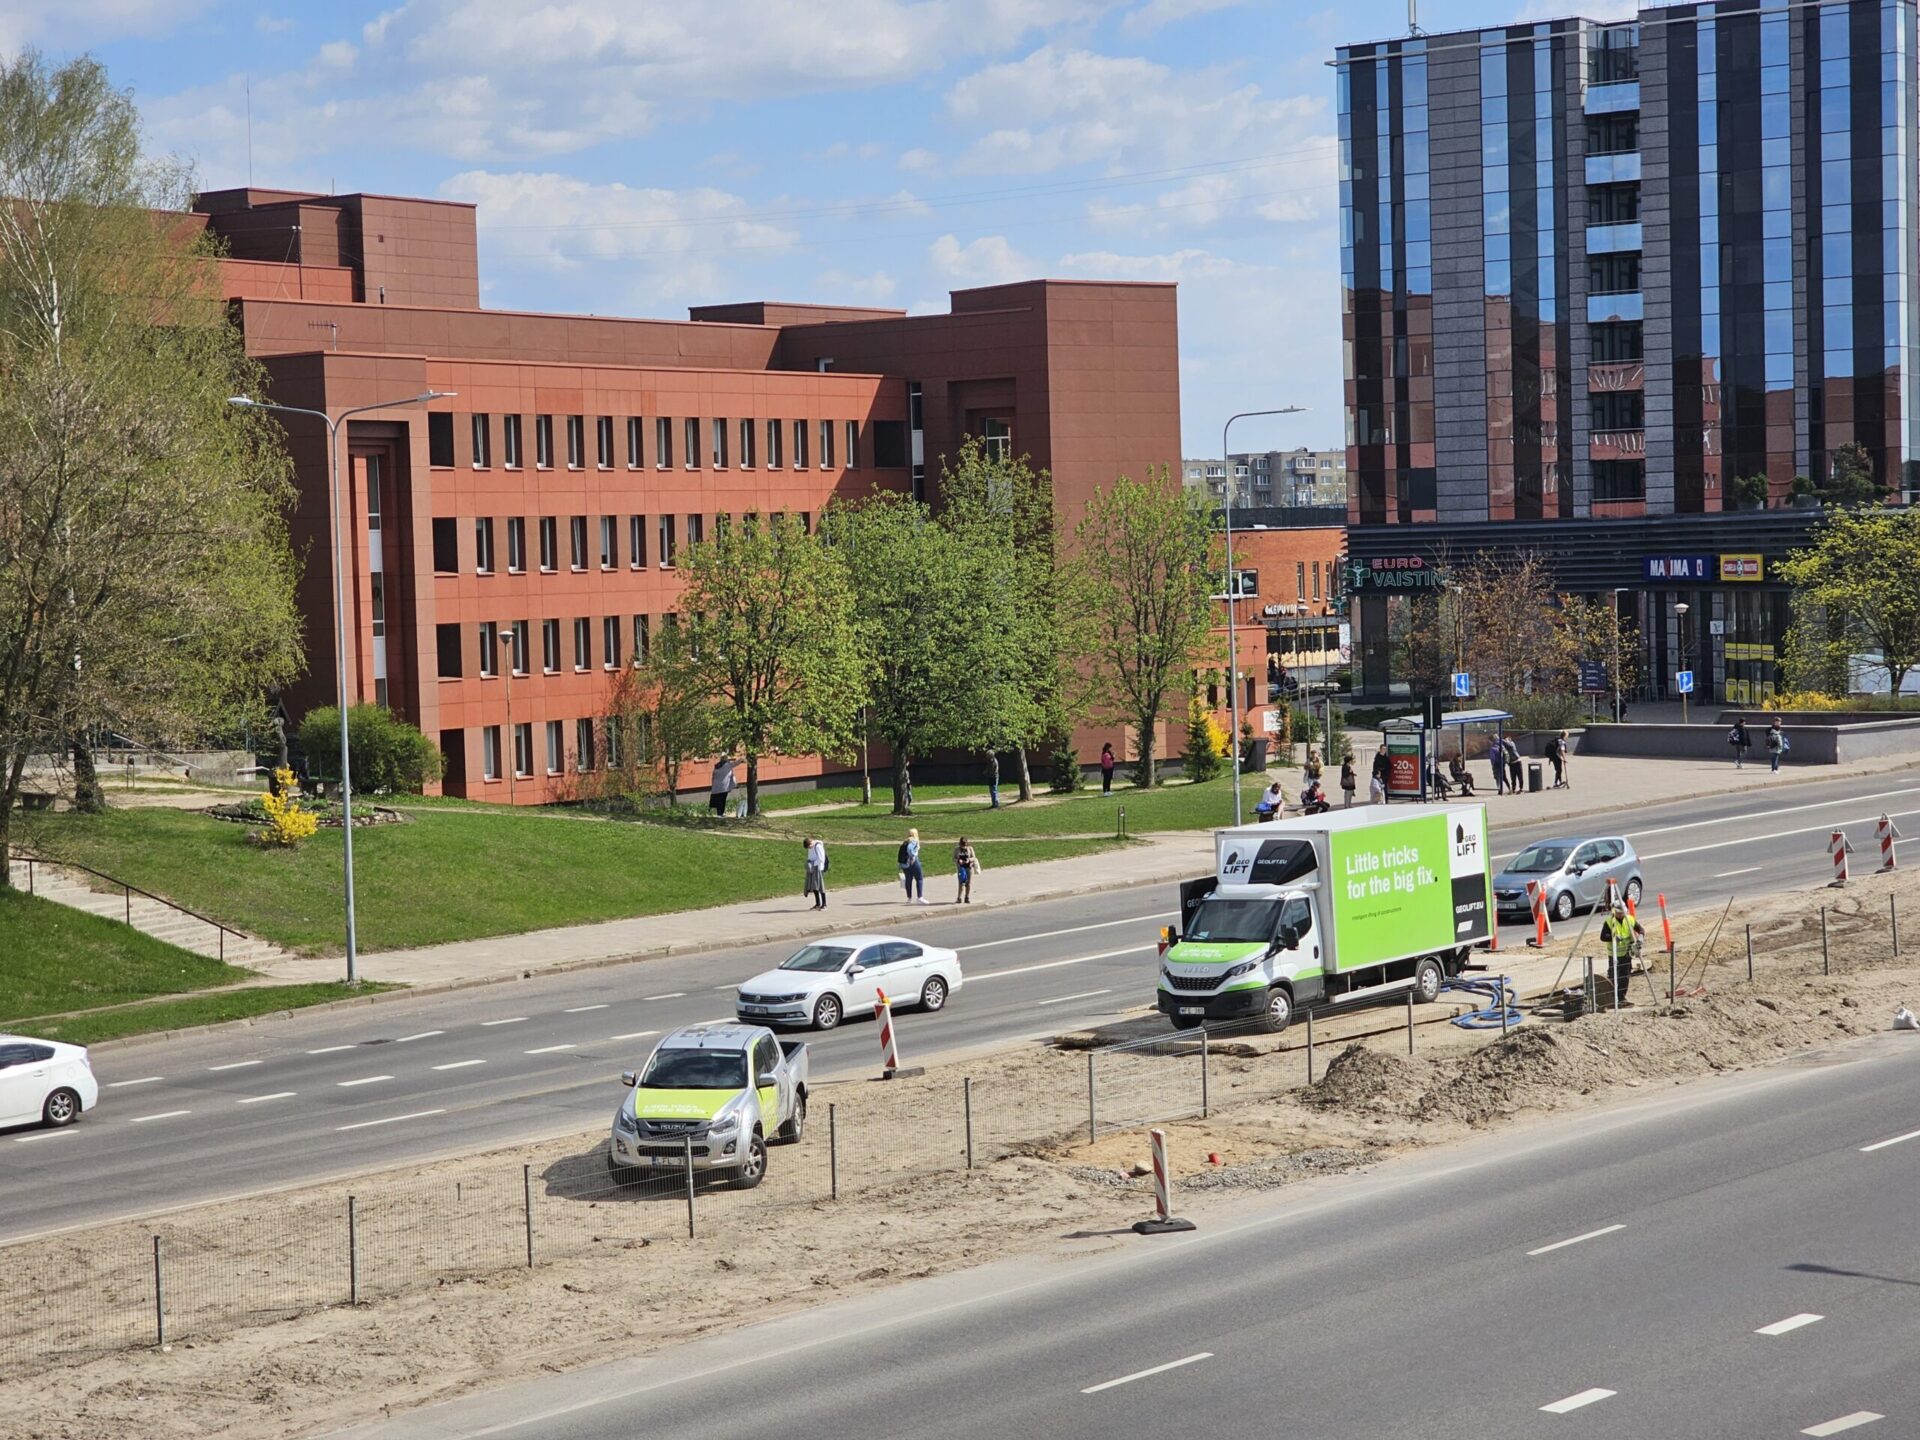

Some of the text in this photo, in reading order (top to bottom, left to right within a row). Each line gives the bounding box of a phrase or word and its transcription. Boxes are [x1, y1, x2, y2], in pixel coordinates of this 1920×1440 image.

[1372, 558, 1422, 569] EURO
[1456, 842, 1477, 857] LIFT
[1346, 845, 1419, 875] Little tricks
[1223, 865, 1248, 874] LIFT
[1347, 880, 1366, 899] for
[1369, 875, 1390, 895] the
[1393, 869, 1415, 892] big
[1455, 901, 1484, 914] GEOLIFT.EU
